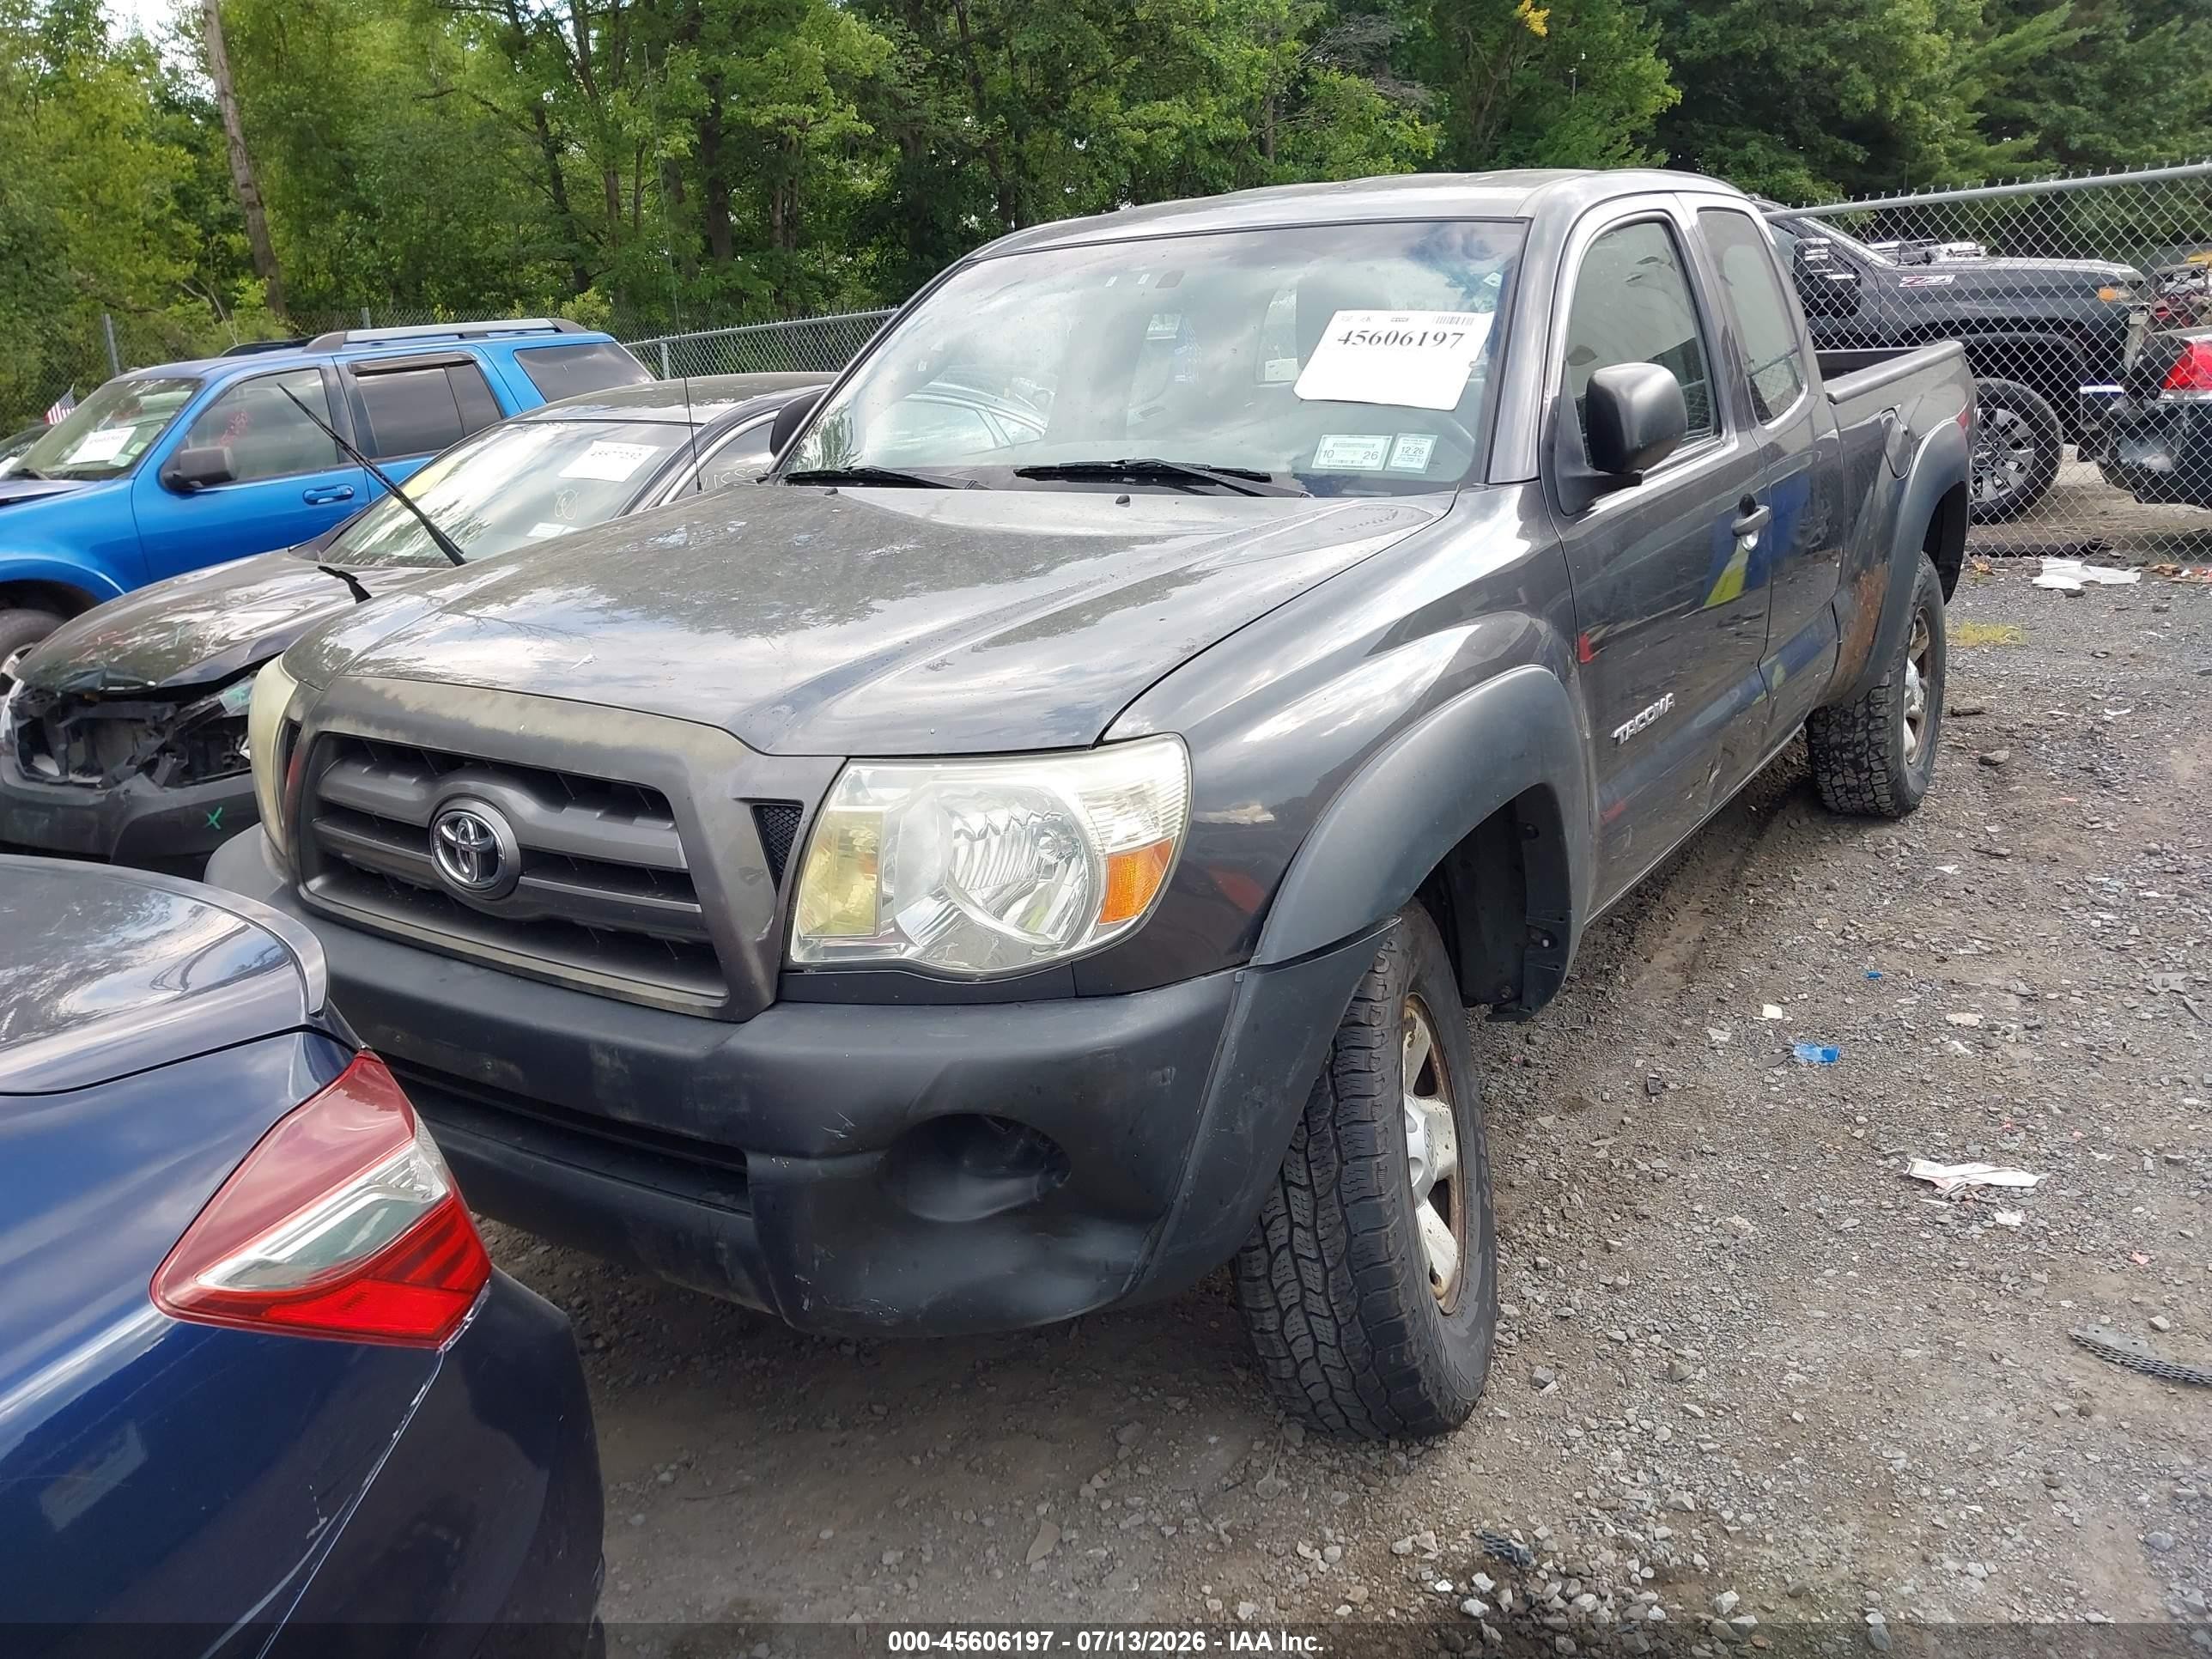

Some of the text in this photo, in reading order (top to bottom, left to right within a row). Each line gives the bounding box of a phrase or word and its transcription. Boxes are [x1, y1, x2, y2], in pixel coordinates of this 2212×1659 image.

[1337, 329, 1465, 349] 45606197
[1323, 449, 1379, 460] 10 26
[1609, 692, 1676, 745] TACOMA
